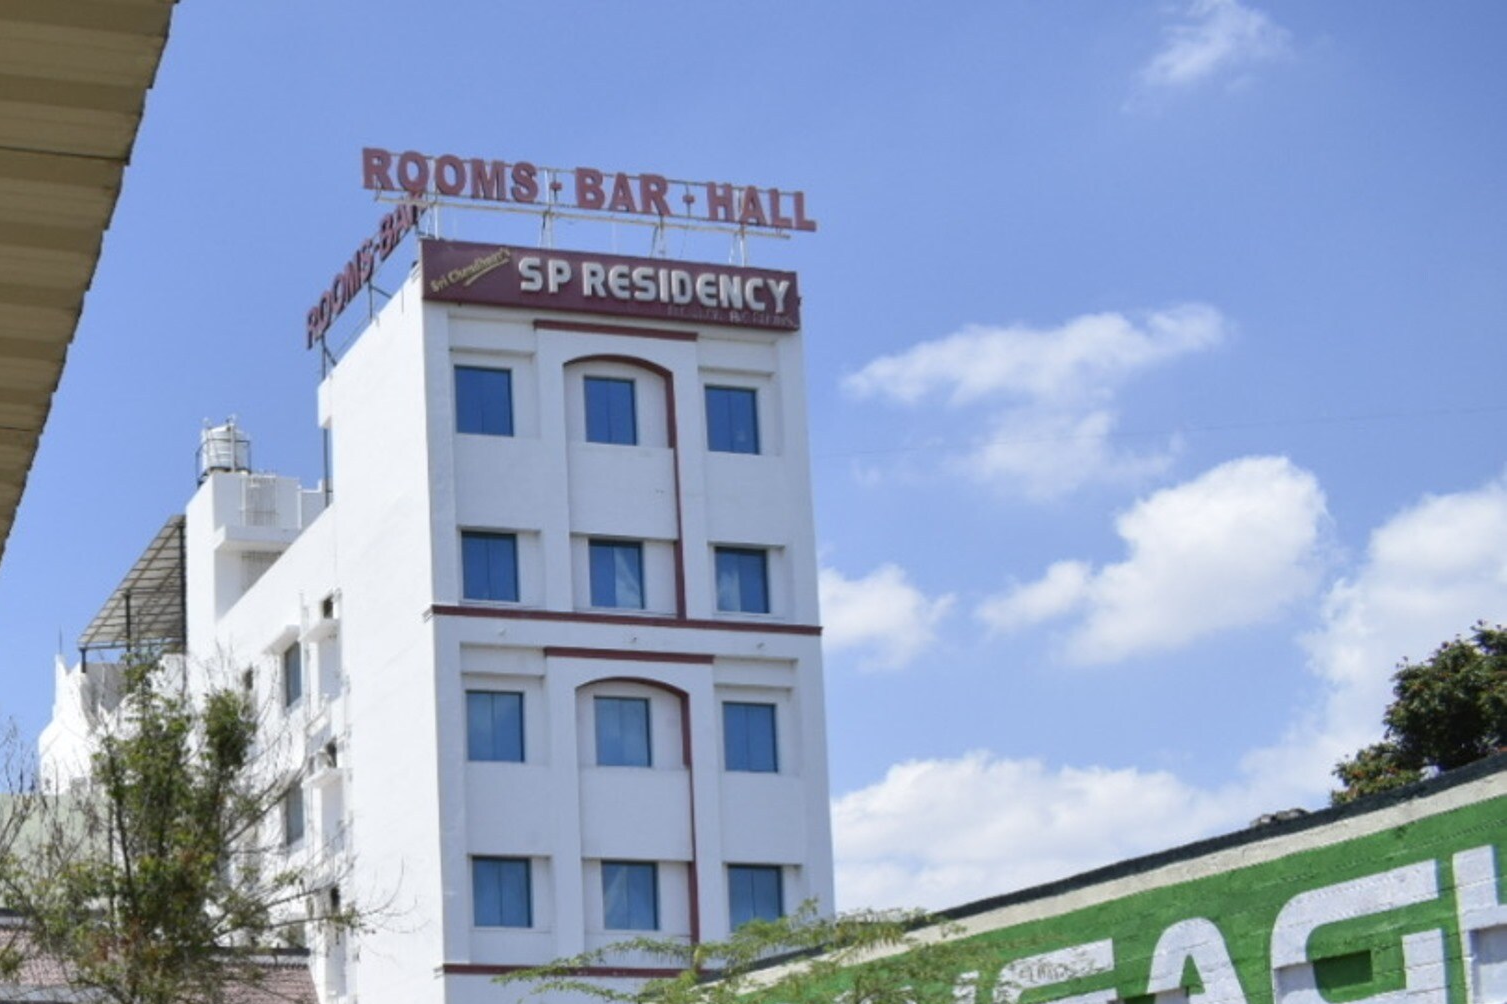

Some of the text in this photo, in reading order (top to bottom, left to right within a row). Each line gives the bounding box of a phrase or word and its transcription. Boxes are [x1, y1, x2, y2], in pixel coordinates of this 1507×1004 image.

[362, 147, 818, 232] ROOMS BAR HALL
[306, 238, 375, 350] ROOMS
[518, 256, 573, 294] SP
[581, 261, 792, 315] RESIDENCY
